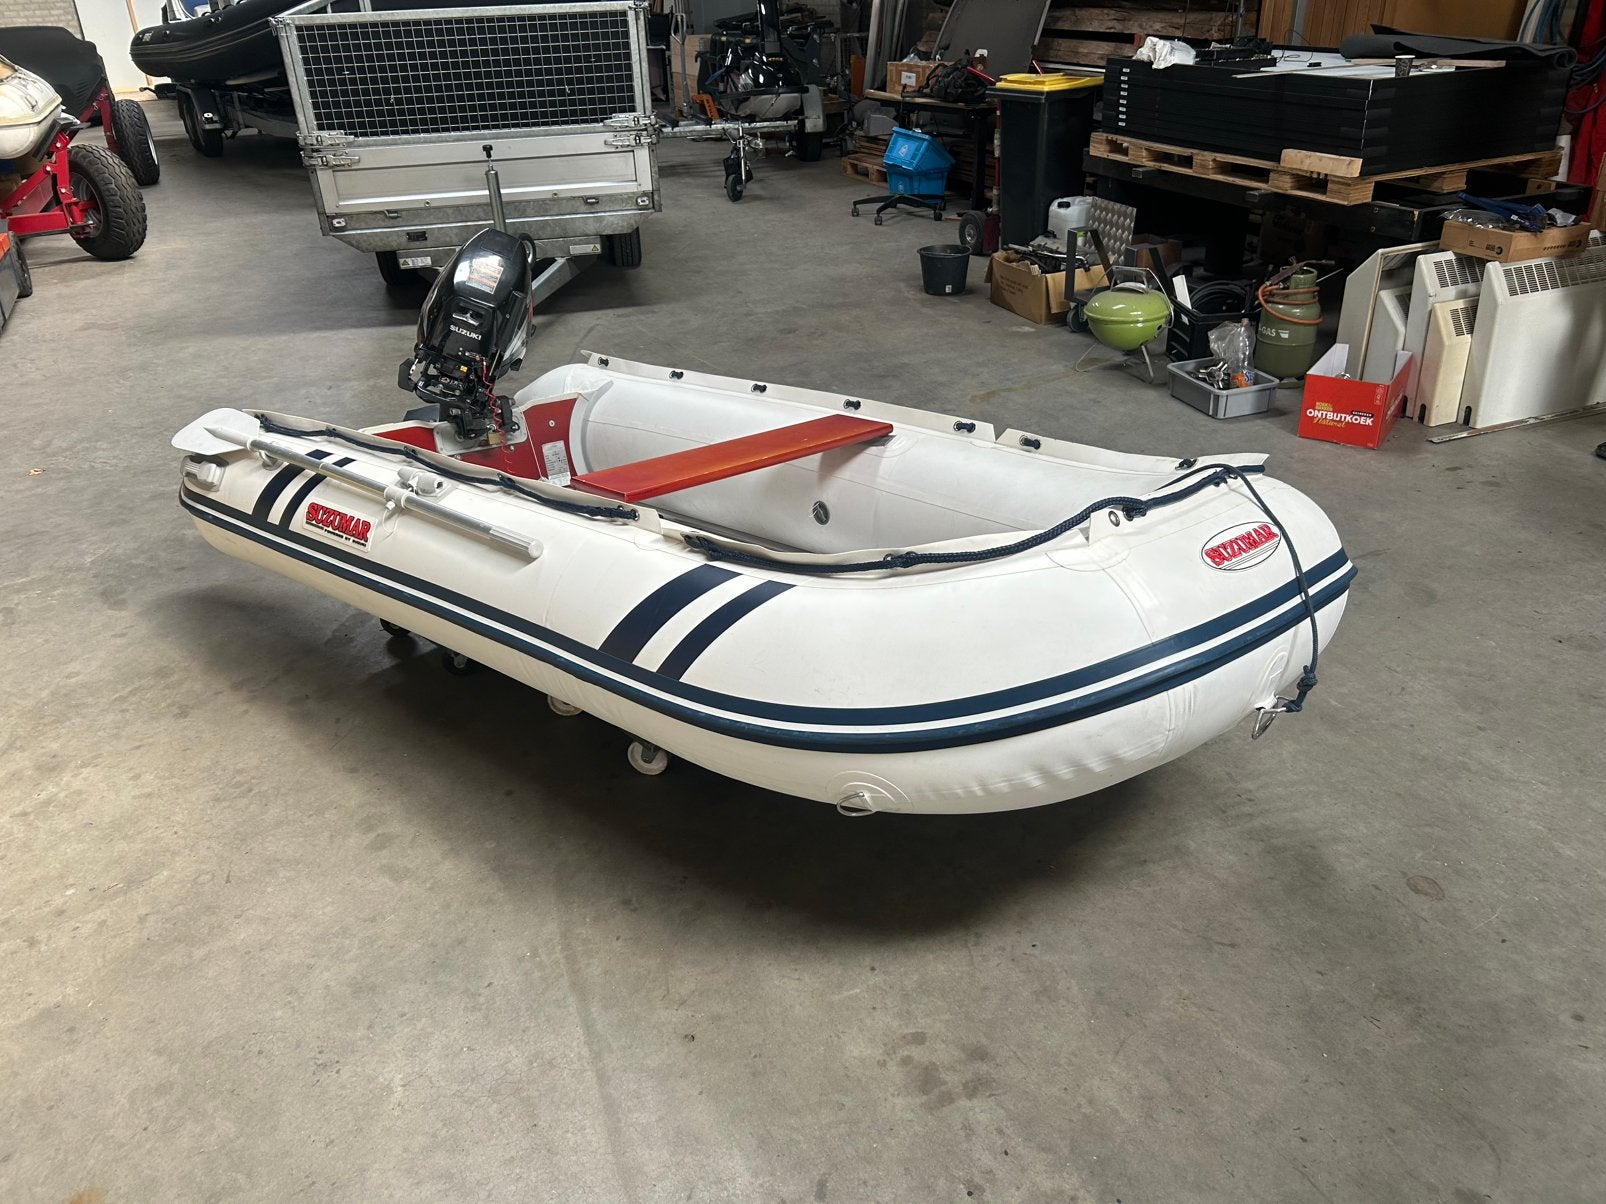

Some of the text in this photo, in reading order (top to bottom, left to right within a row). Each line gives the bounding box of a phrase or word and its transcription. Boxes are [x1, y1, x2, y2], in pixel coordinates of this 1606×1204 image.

[449, 324, 482, 341] SUZUKI
[1306, 408, 1374, 426] ONTBIJTKOEK
[305, 502, 371, 543] SUZUMAR
[1204, 523, 1279, 567] SUZUMAR
